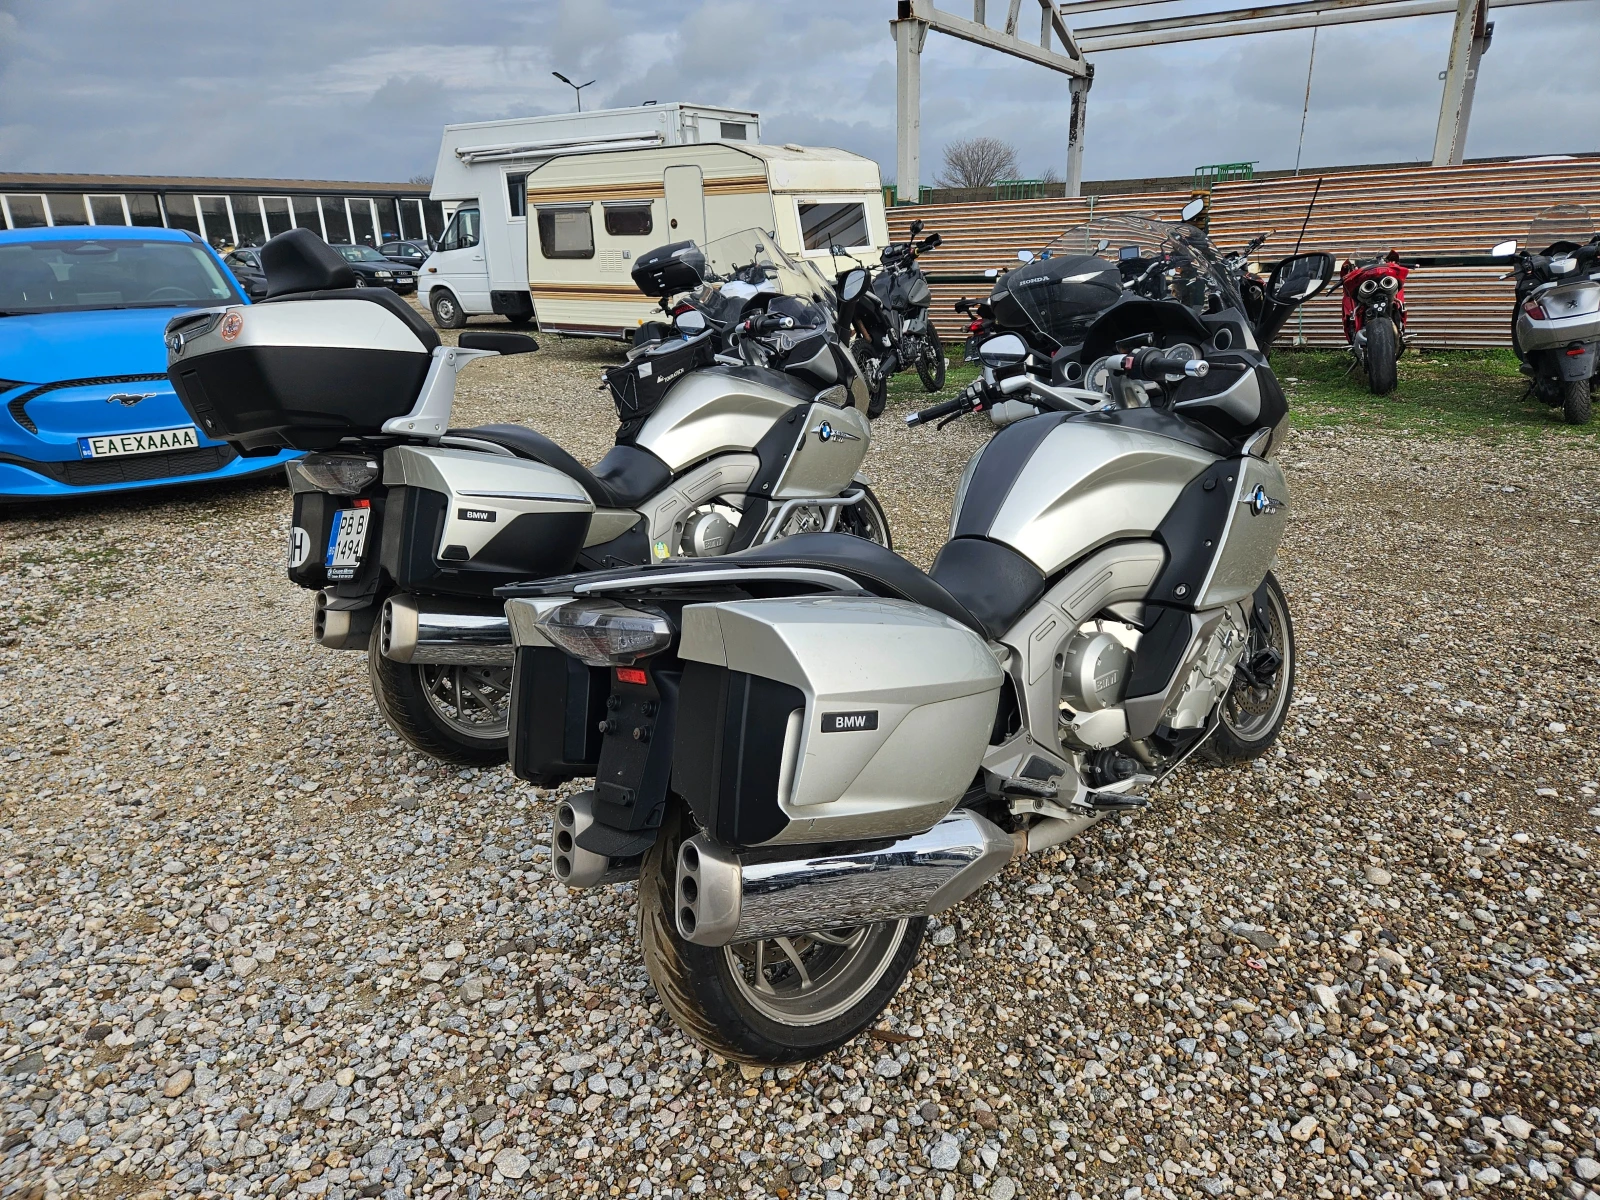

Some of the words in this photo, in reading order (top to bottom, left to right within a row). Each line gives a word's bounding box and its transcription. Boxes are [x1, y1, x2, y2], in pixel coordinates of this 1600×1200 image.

[1019, 275, 1050, 287] HONDA
[467, 511, 488, 520] BMW
[336, 539, 361, 560] 1494
[835, 715, 866, 728] BMW
